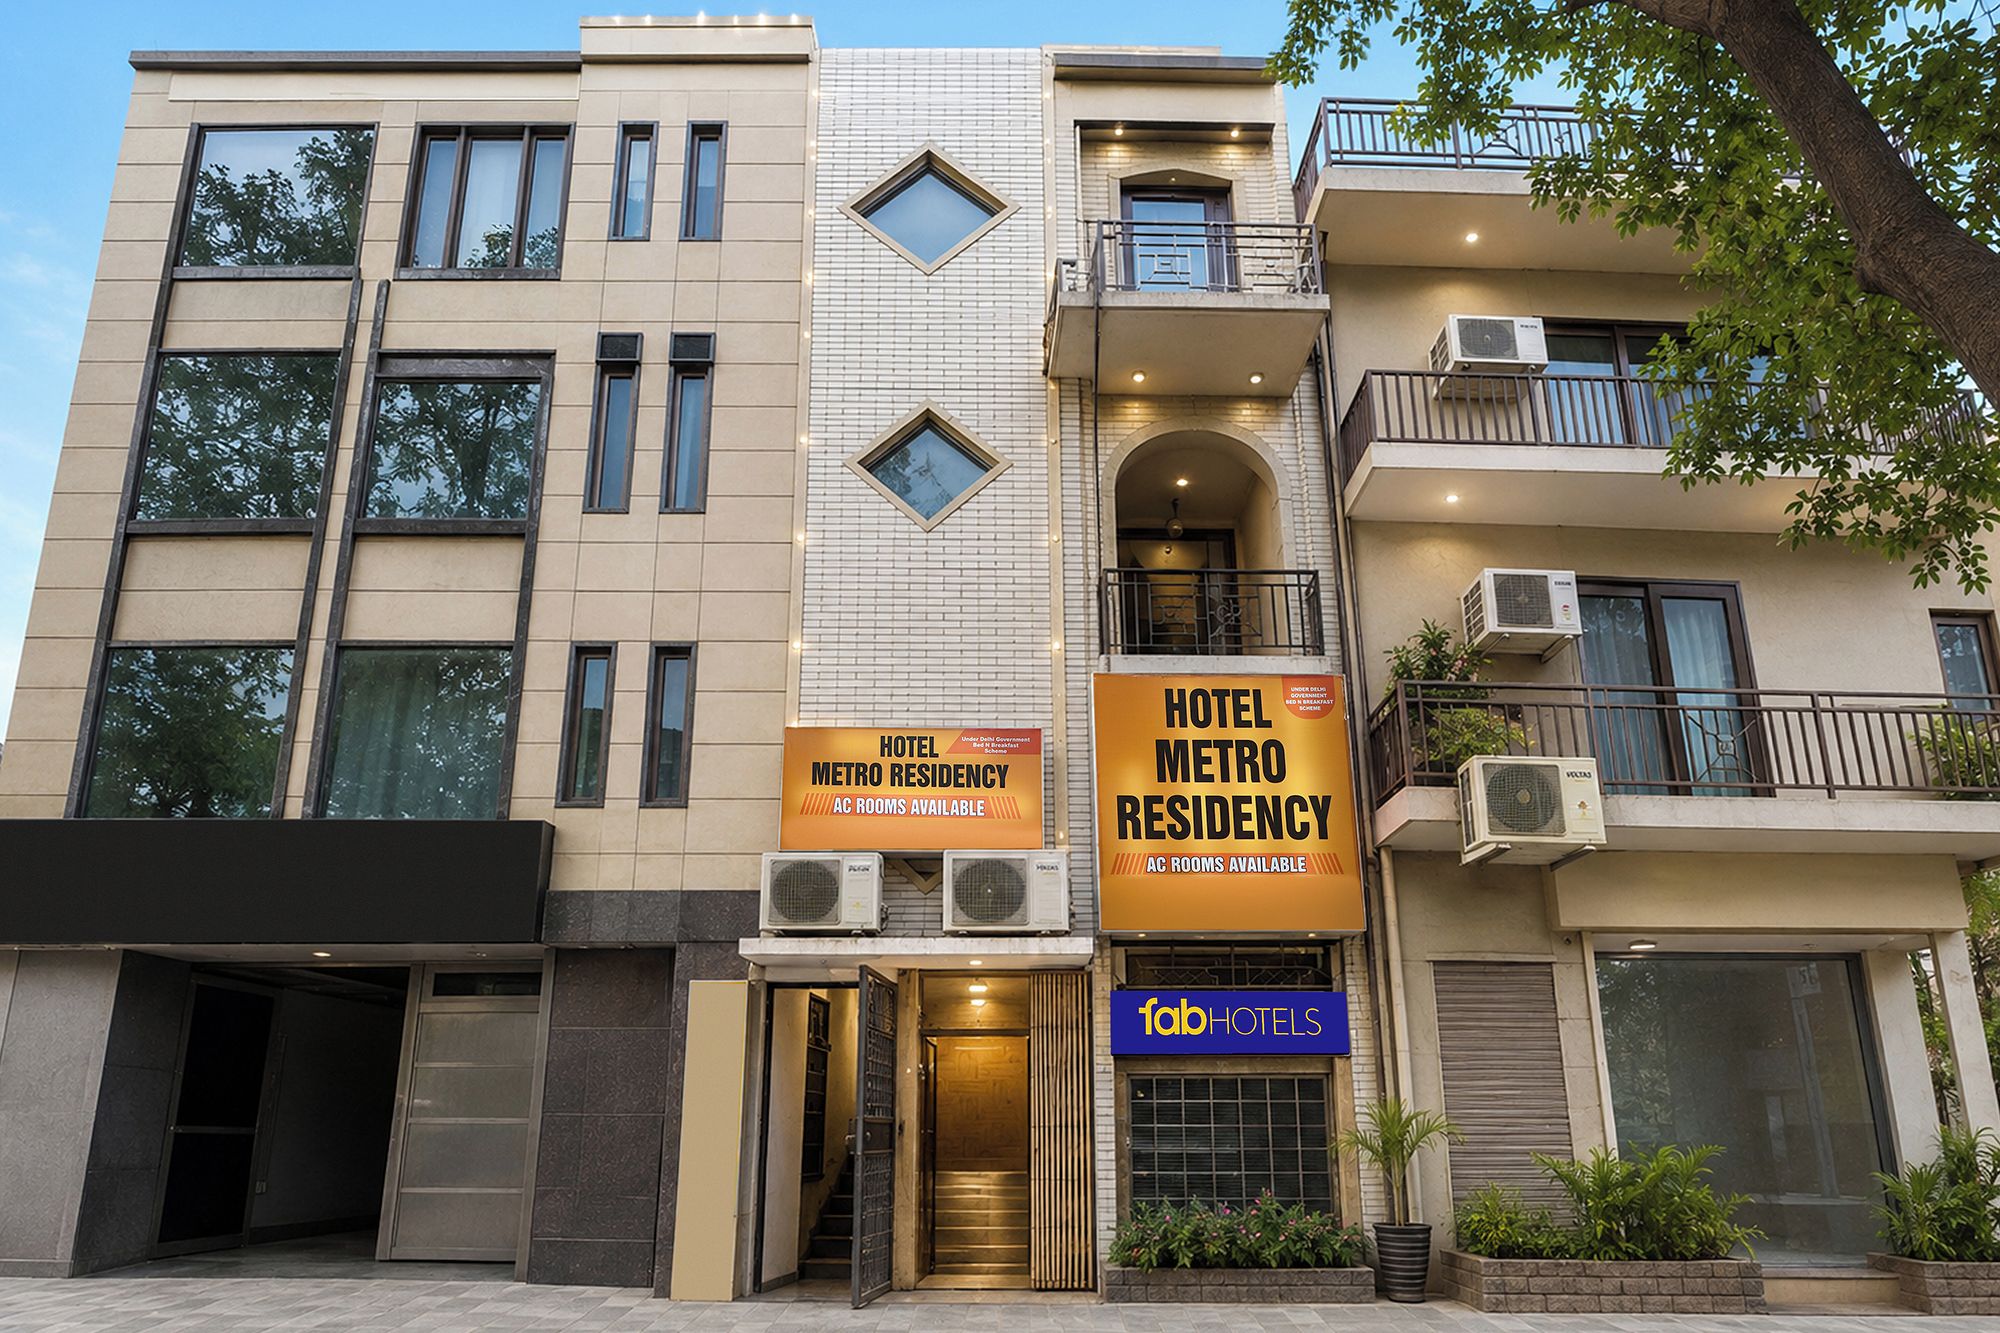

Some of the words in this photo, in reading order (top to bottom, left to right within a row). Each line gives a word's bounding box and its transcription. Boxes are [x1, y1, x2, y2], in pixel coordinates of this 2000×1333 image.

[1164, 688, 1273, 729] HOTEL
[880, 735, 939, 758] HOTEL
[1155, 738, 1287, 784] METRO
[811, 762, 883, 787] METRO
[890, 763, 1009, 789] RESIDENCY
[833, 797, 852, 814] AC
[856, 798, 907, 815] ROOMS
[910, 799, 985, 817] AVAILABLE
[1116, 794, 1332, 840] RESIDENCY
[1146, 856, 1166, 873] AC
[1171, 856, 1224, 873] ROOMS
[1228, 856, 1307, 873] AVAILABLE
